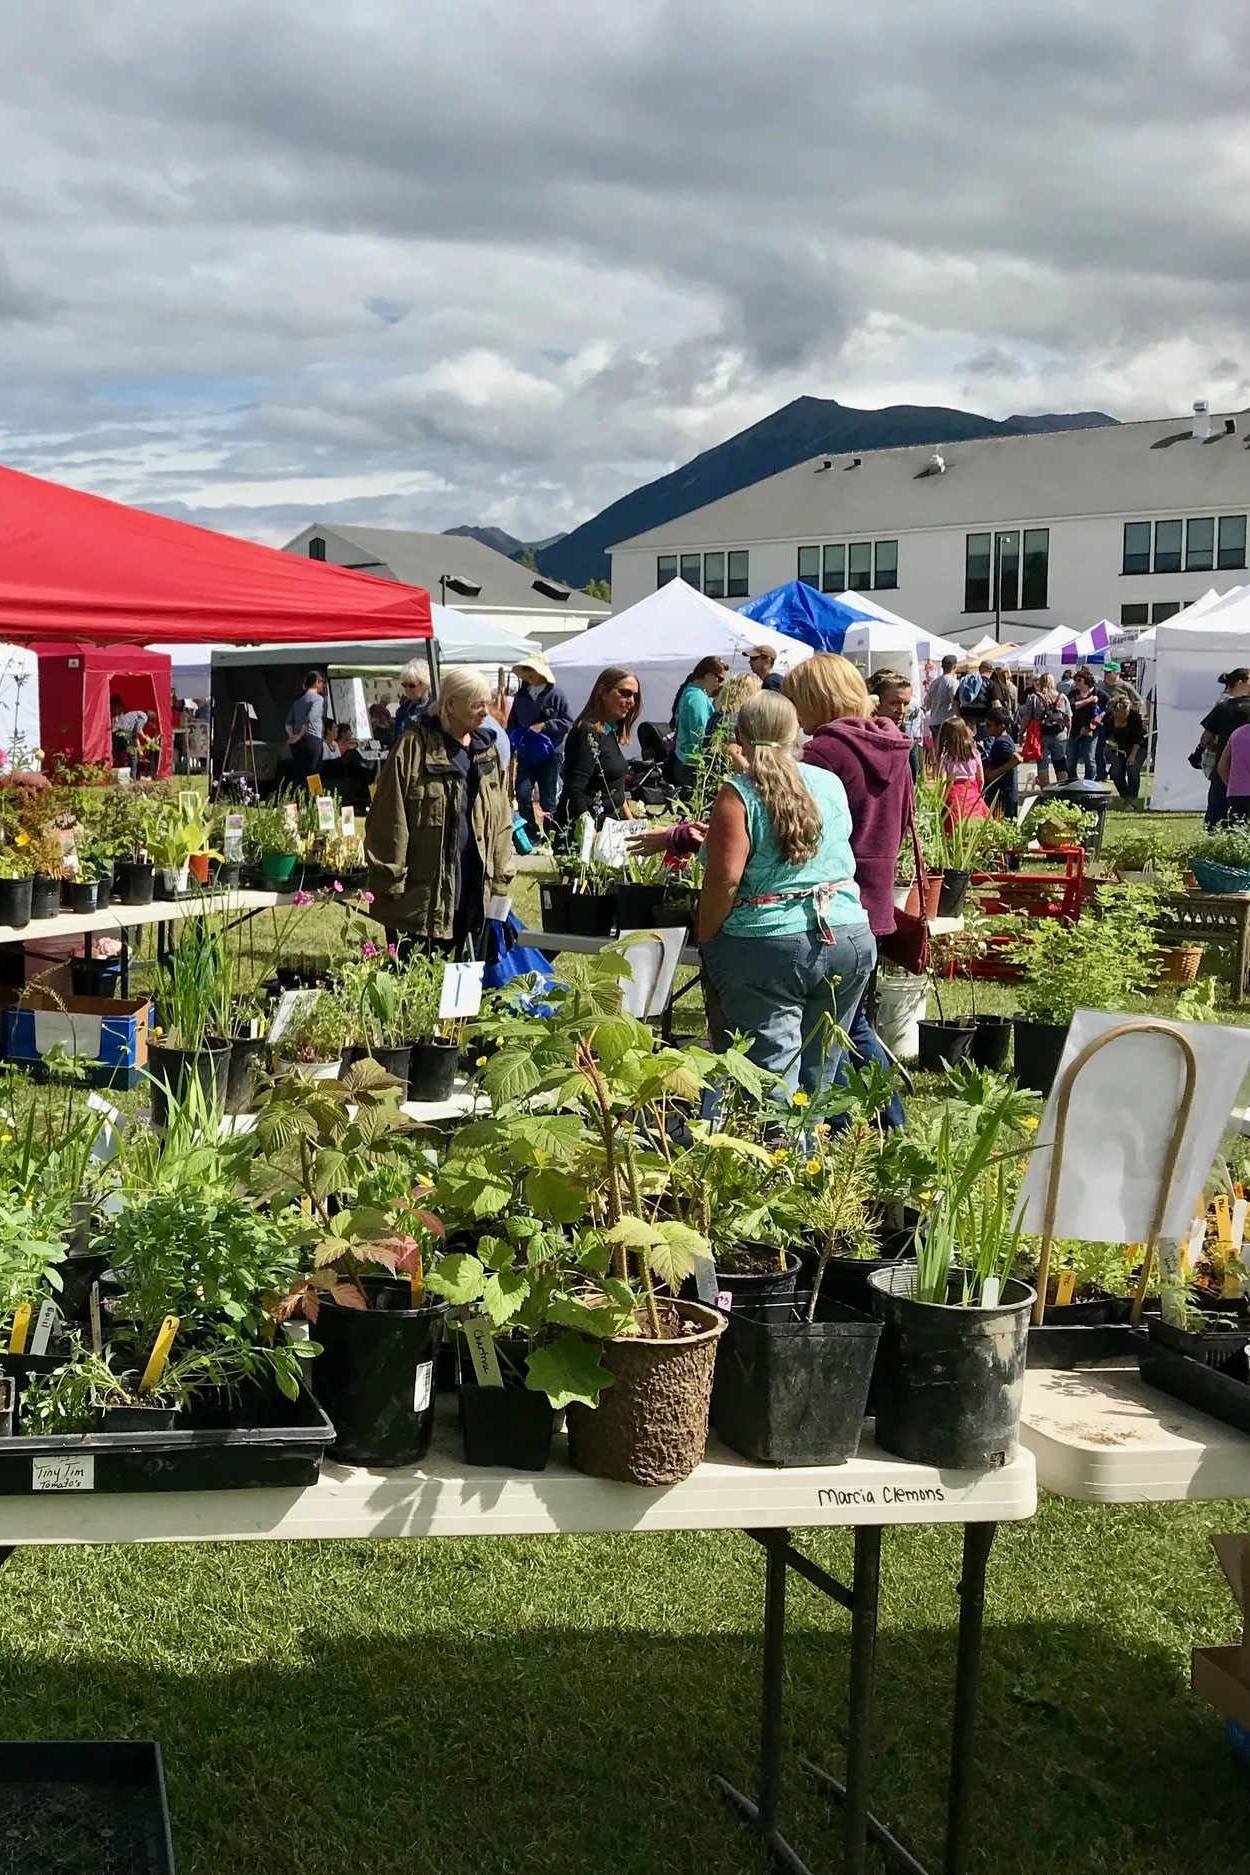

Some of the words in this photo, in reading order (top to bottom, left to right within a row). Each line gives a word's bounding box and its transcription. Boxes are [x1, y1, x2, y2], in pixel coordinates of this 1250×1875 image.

[166, 1318, 176, 1331] 2
[34, 1463, 61, 1484] Tiny
[64, 1461, 84, 1478] Tim
[817, 1488, 876, 1507] Marcia
[882, 1486, 945, 1503] Clemons
